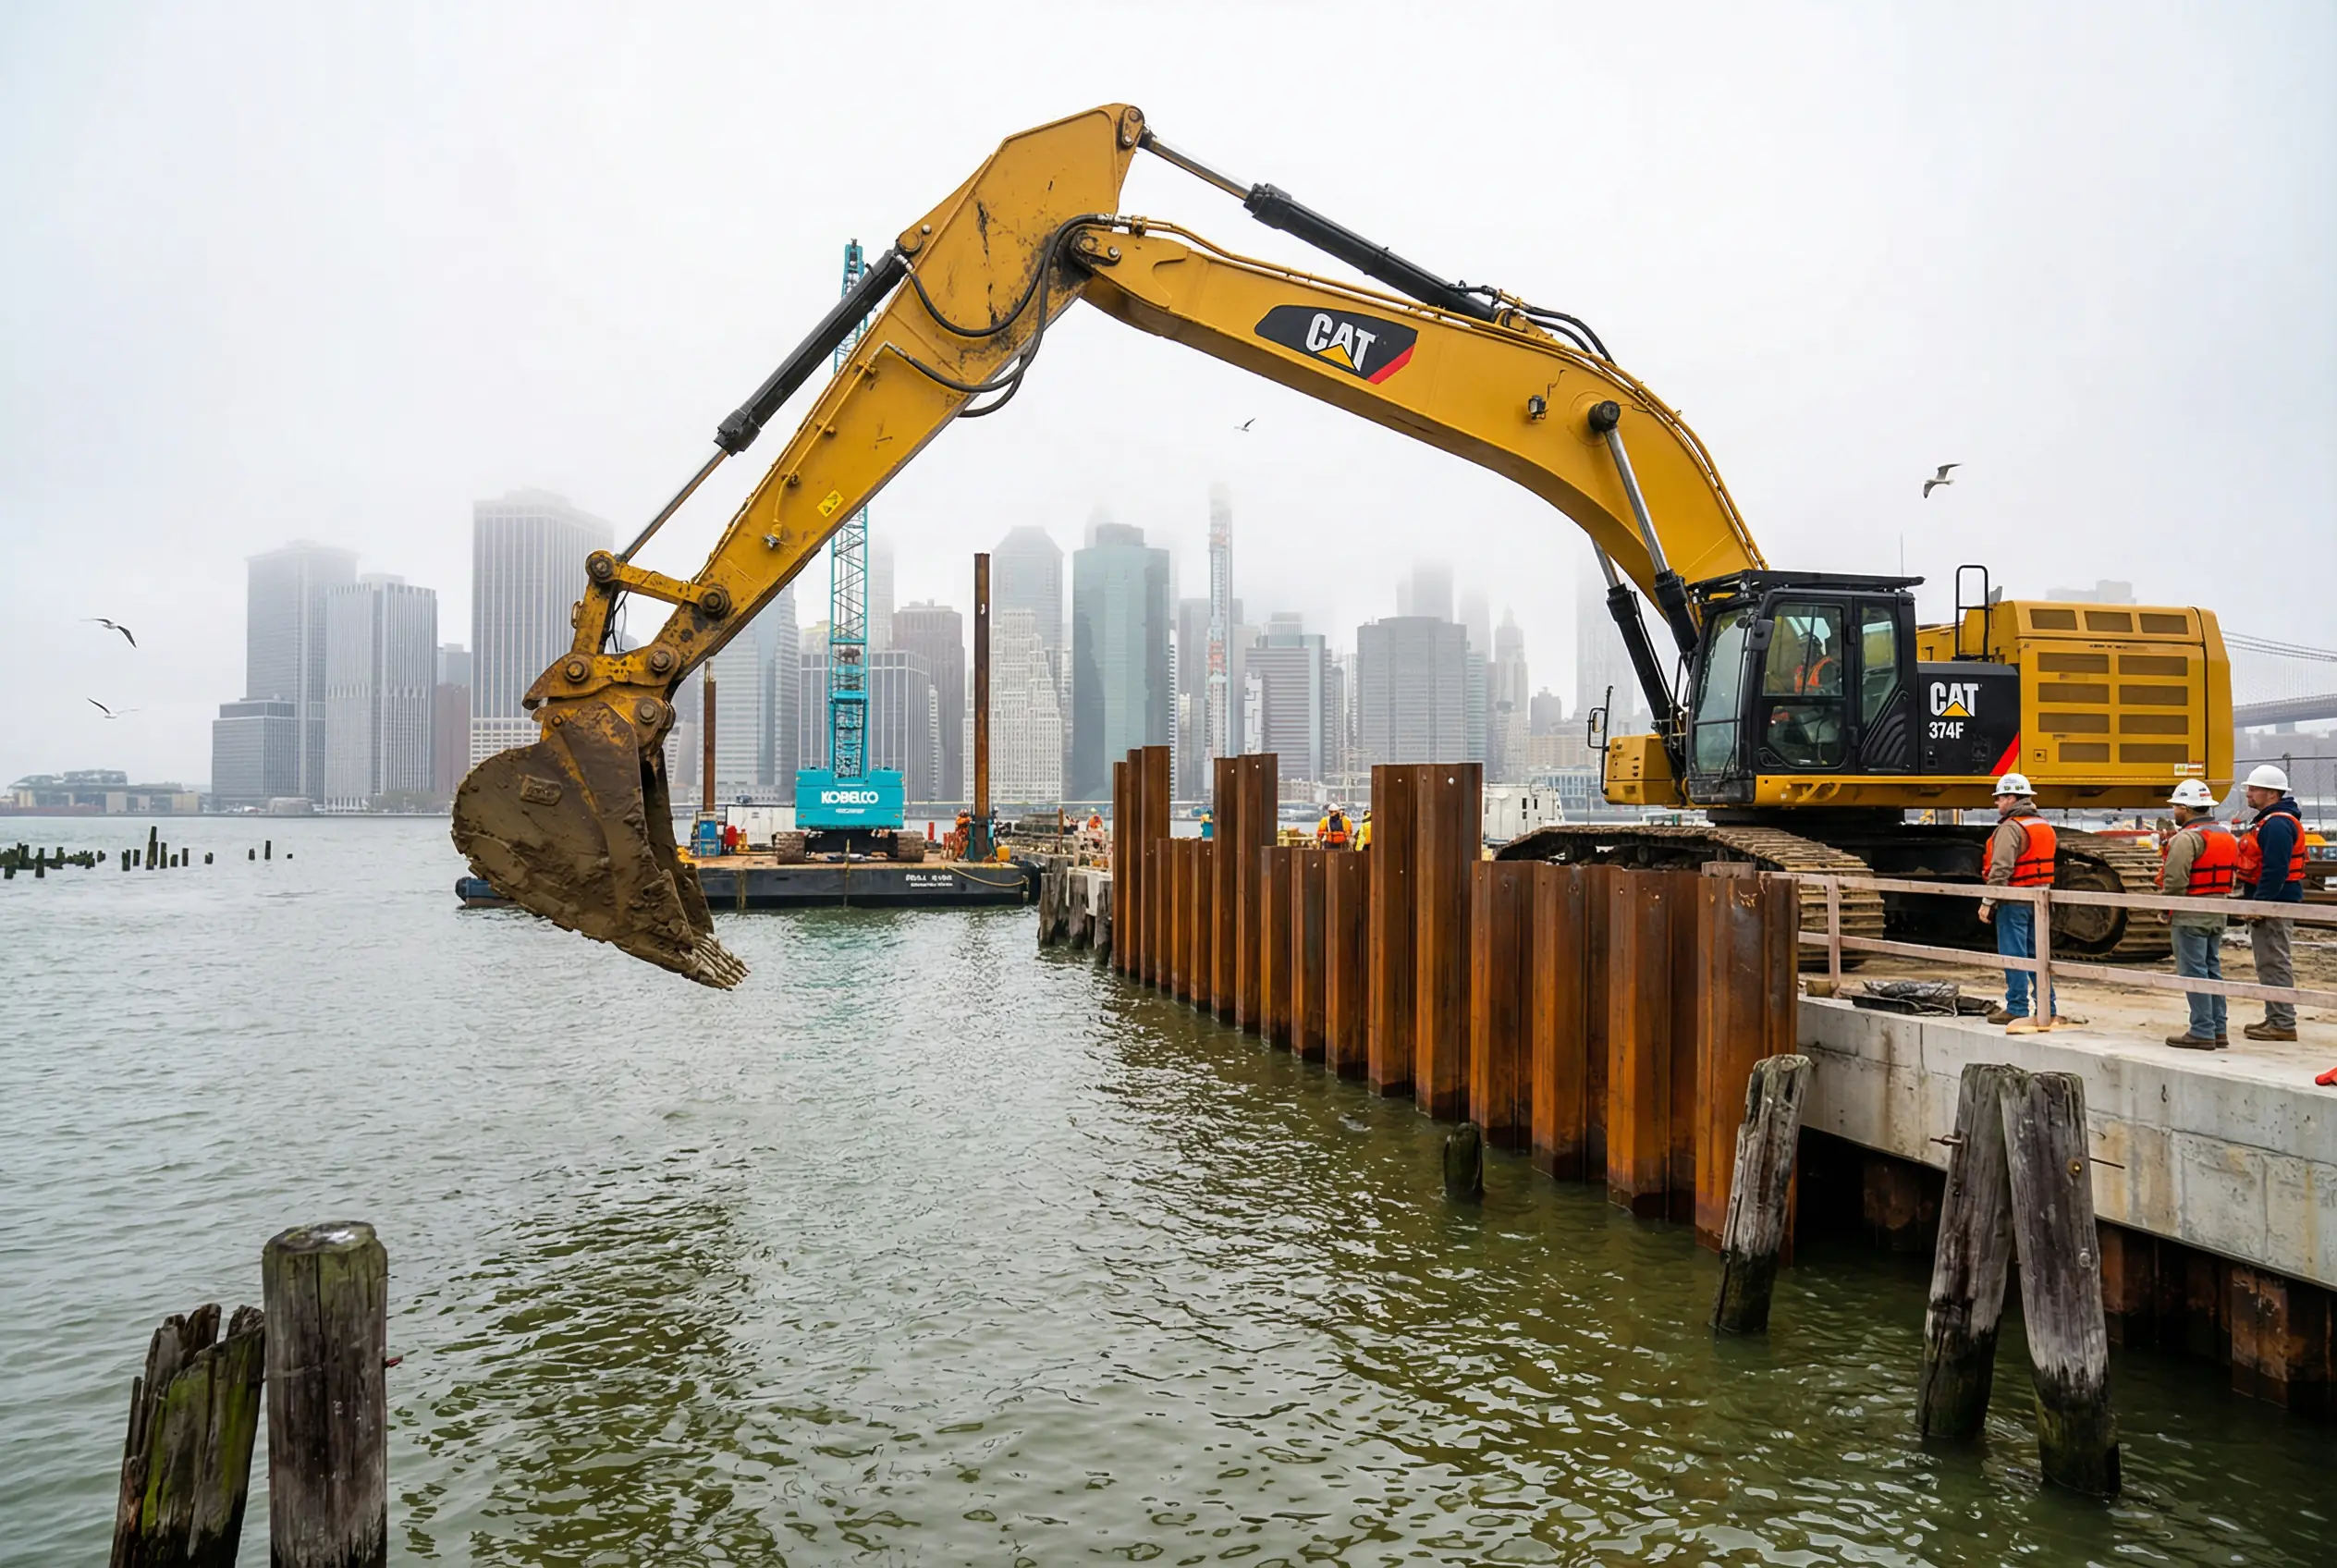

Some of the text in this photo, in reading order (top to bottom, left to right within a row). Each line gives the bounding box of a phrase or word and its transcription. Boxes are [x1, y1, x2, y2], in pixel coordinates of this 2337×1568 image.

[1306, 313, 1377, 372] CAT
[1930, 681, 1978, 717] CAT
[1929, 722, 1964, 739] 374F
[821, 790, 878, 803] KOBELCO
